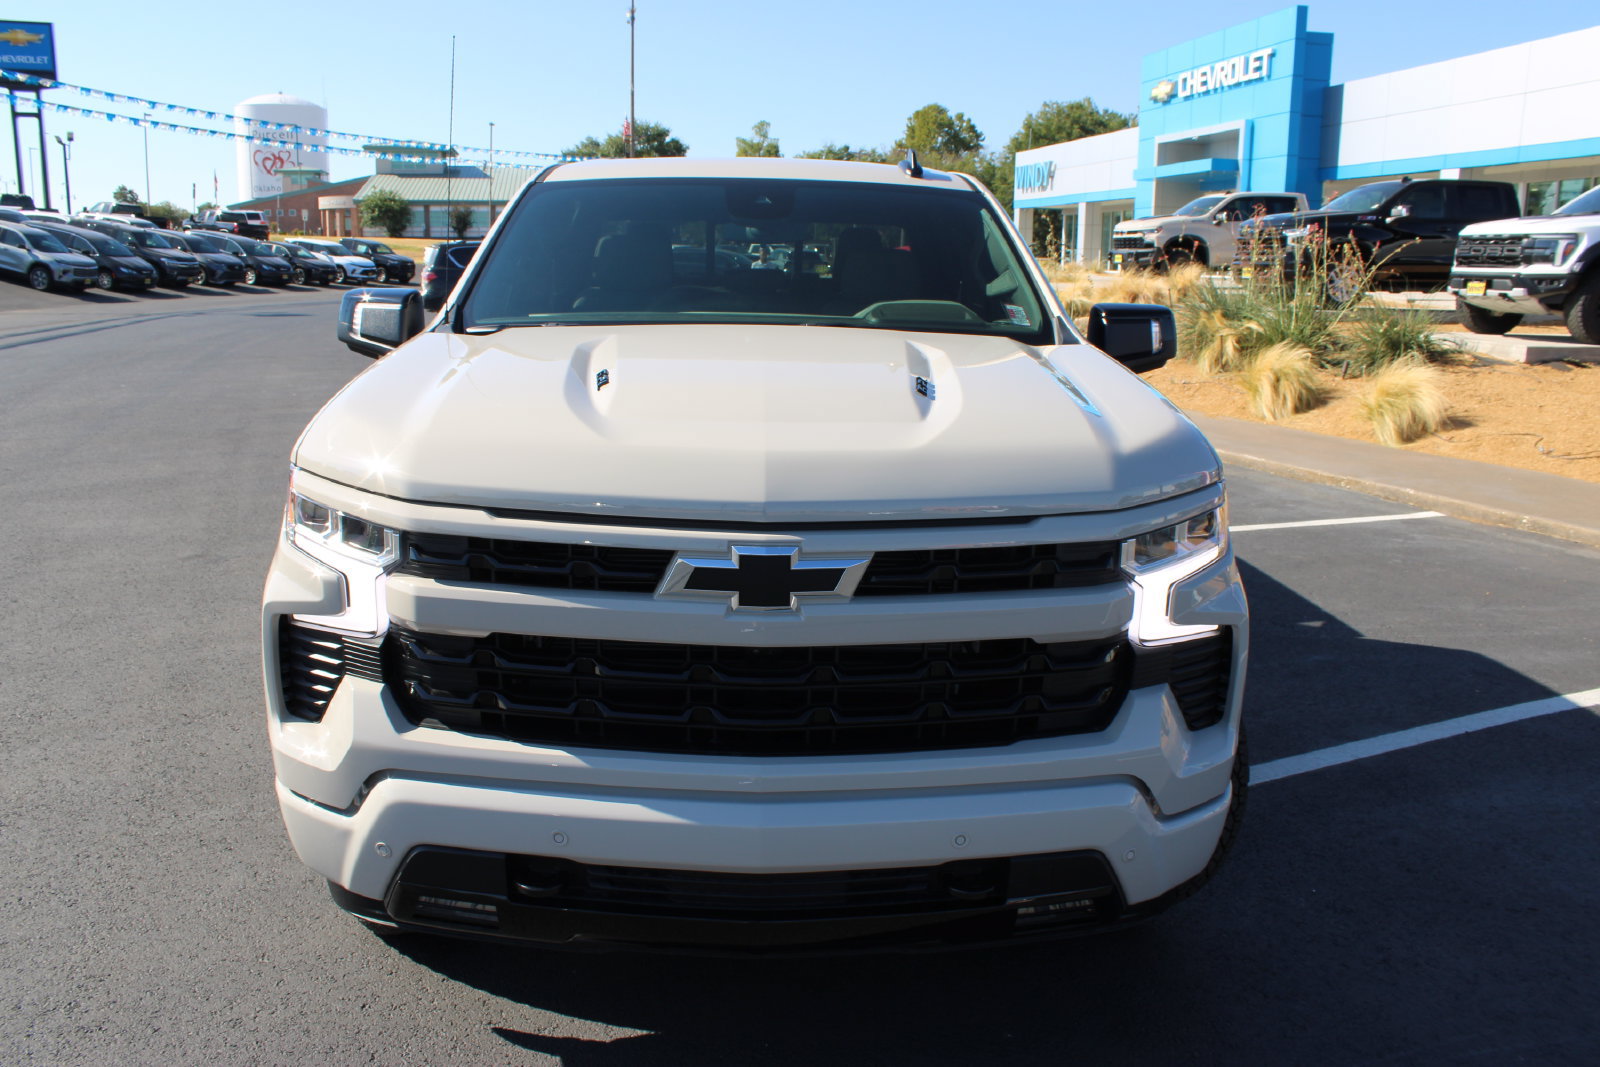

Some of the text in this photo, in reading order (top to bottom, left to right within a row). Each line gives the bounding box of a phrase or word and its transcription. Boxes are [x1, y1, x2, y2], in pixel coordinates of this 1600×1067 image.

[0, 54, 48, 64] HEVROLET
[1177, 47, 1274, 98] CHEVROLET
[252, 129, 294, 140] Purcell
[1015, 161, 1052, 190] WINDY
[254, 184, 282, 193] Oklaho
[1455, 245, 1522, 257] FORD
